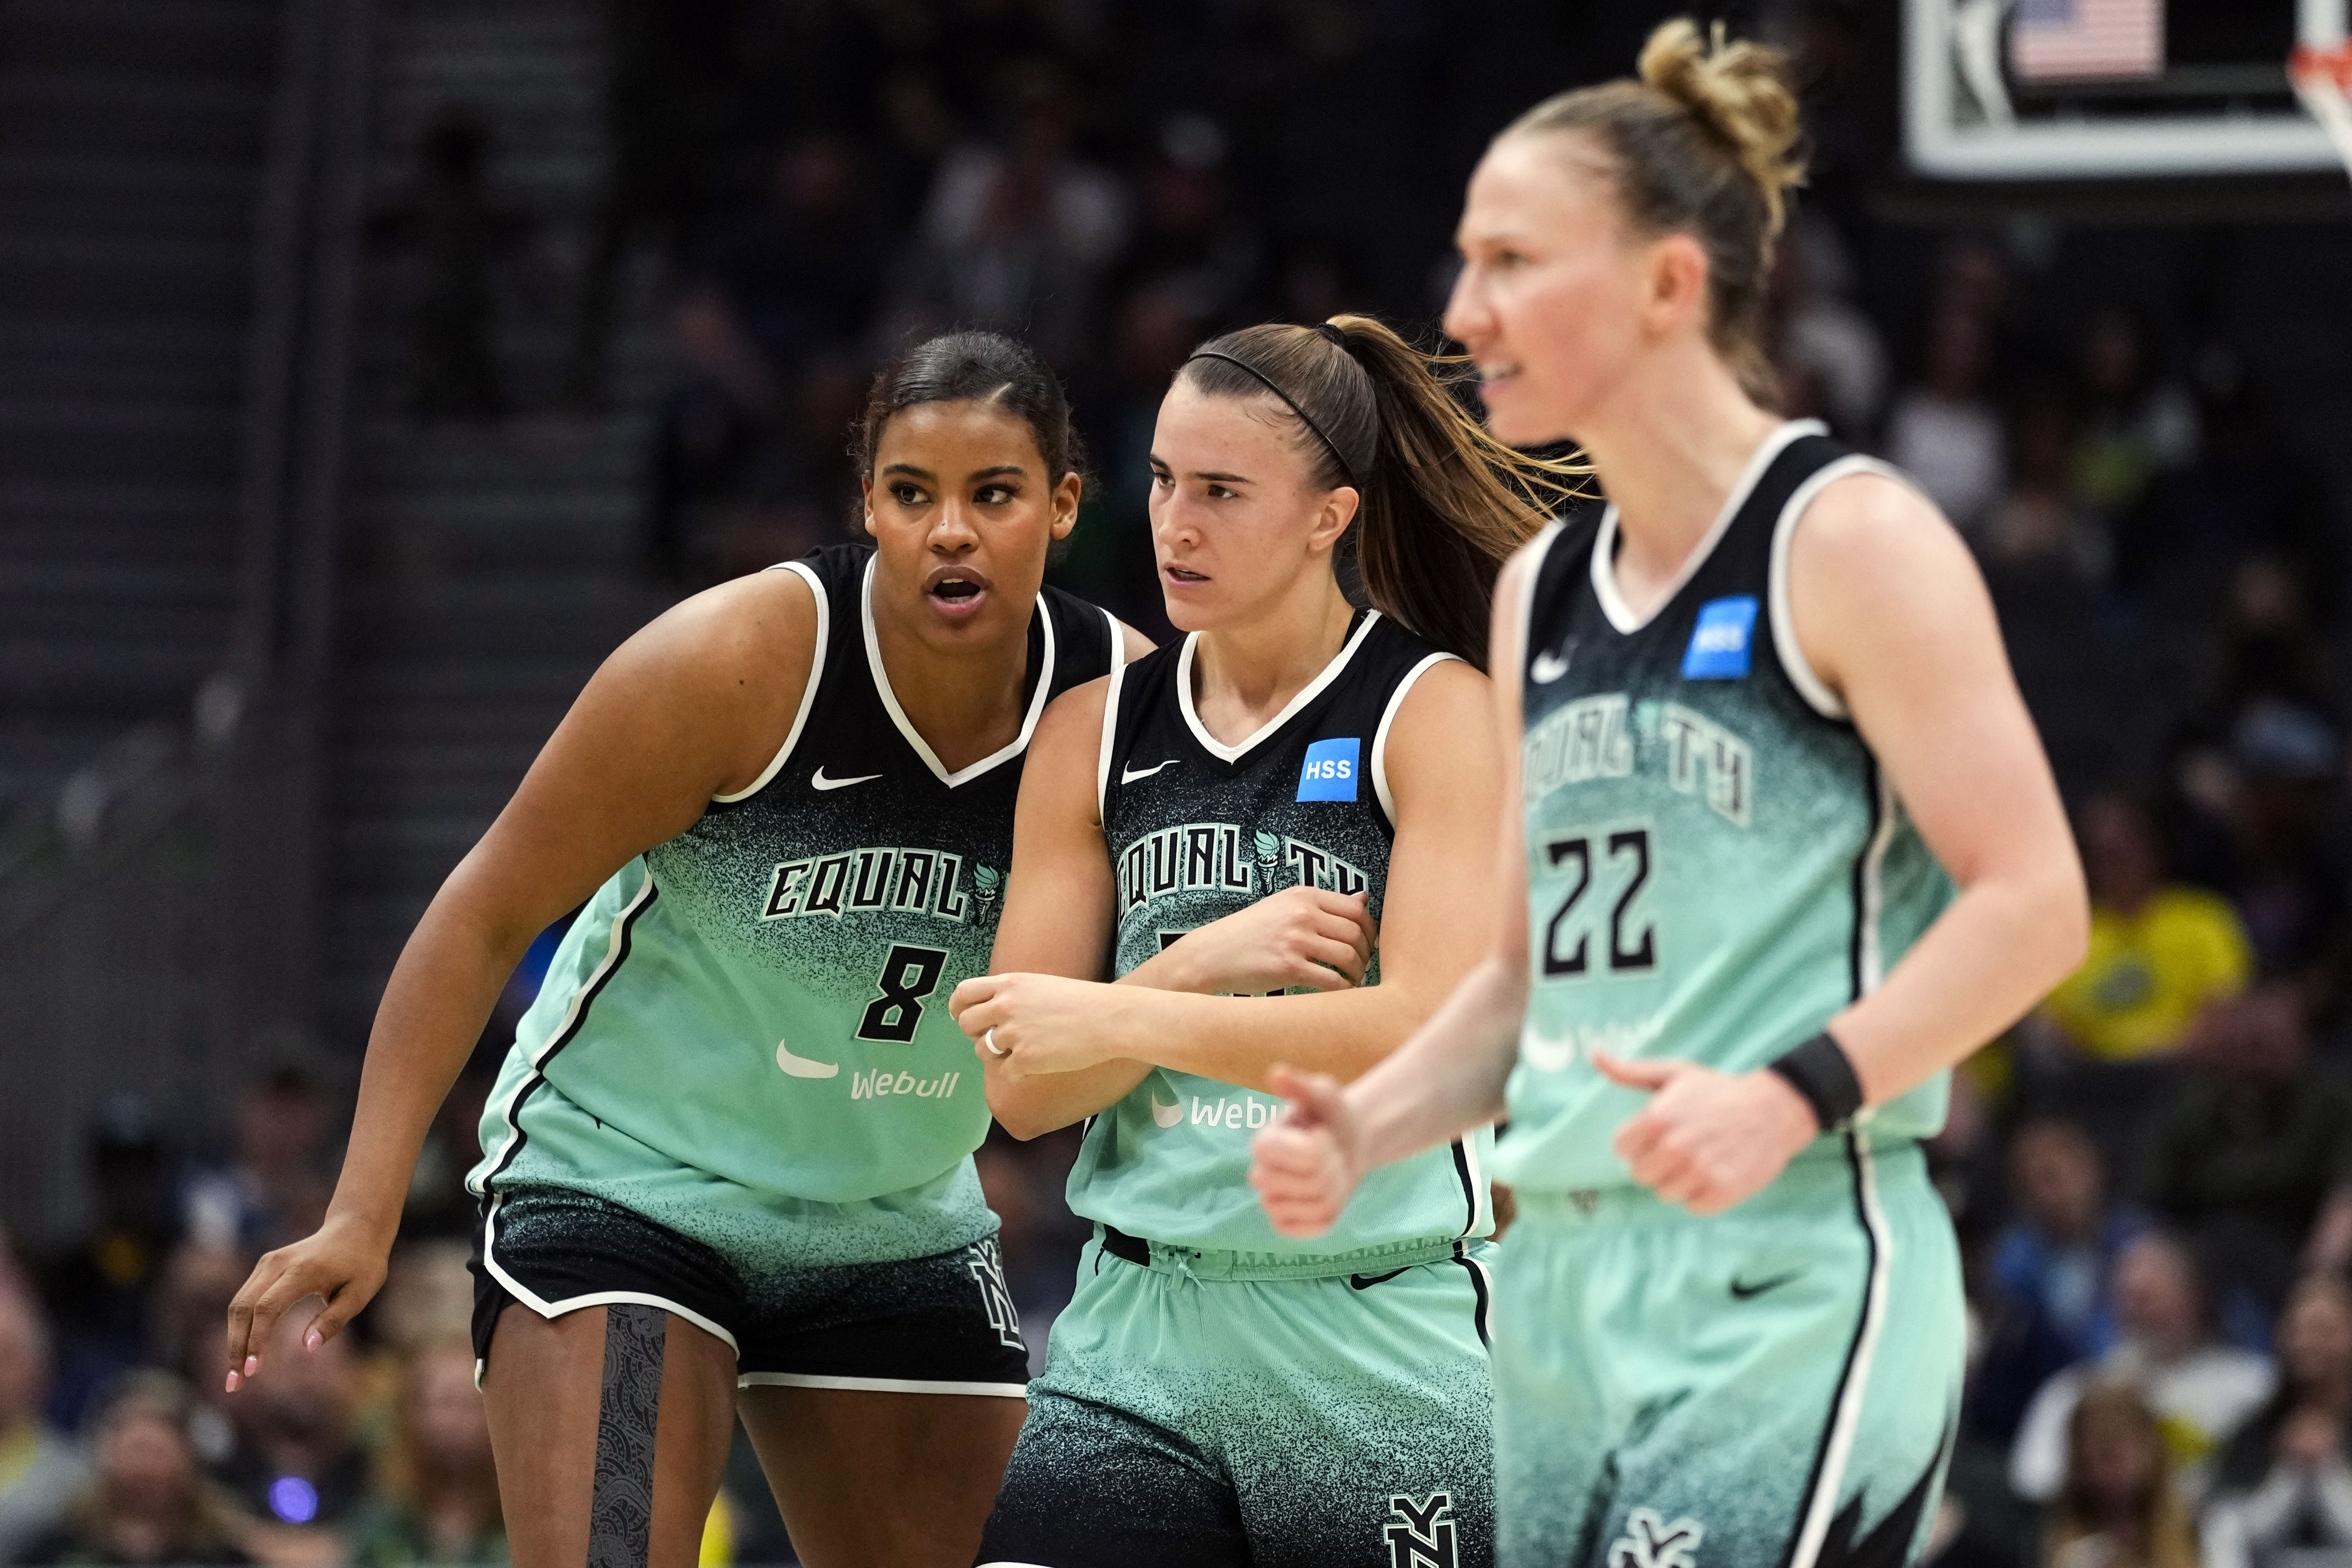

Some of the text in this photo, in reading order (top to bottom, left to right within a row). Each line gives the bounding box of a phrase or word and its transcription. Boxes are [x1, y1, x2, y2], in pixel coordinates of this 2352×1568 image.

[1306, 760, 1351, 780] HSS
[761, 846, 966, 921] EQUAL
[1542, 826, 1659, 980] 22
[854, 942, 951, 1045] 8
[851, 1068, 960, 1100] Webull
[1190, 1095, 1290, 1130] Webu
